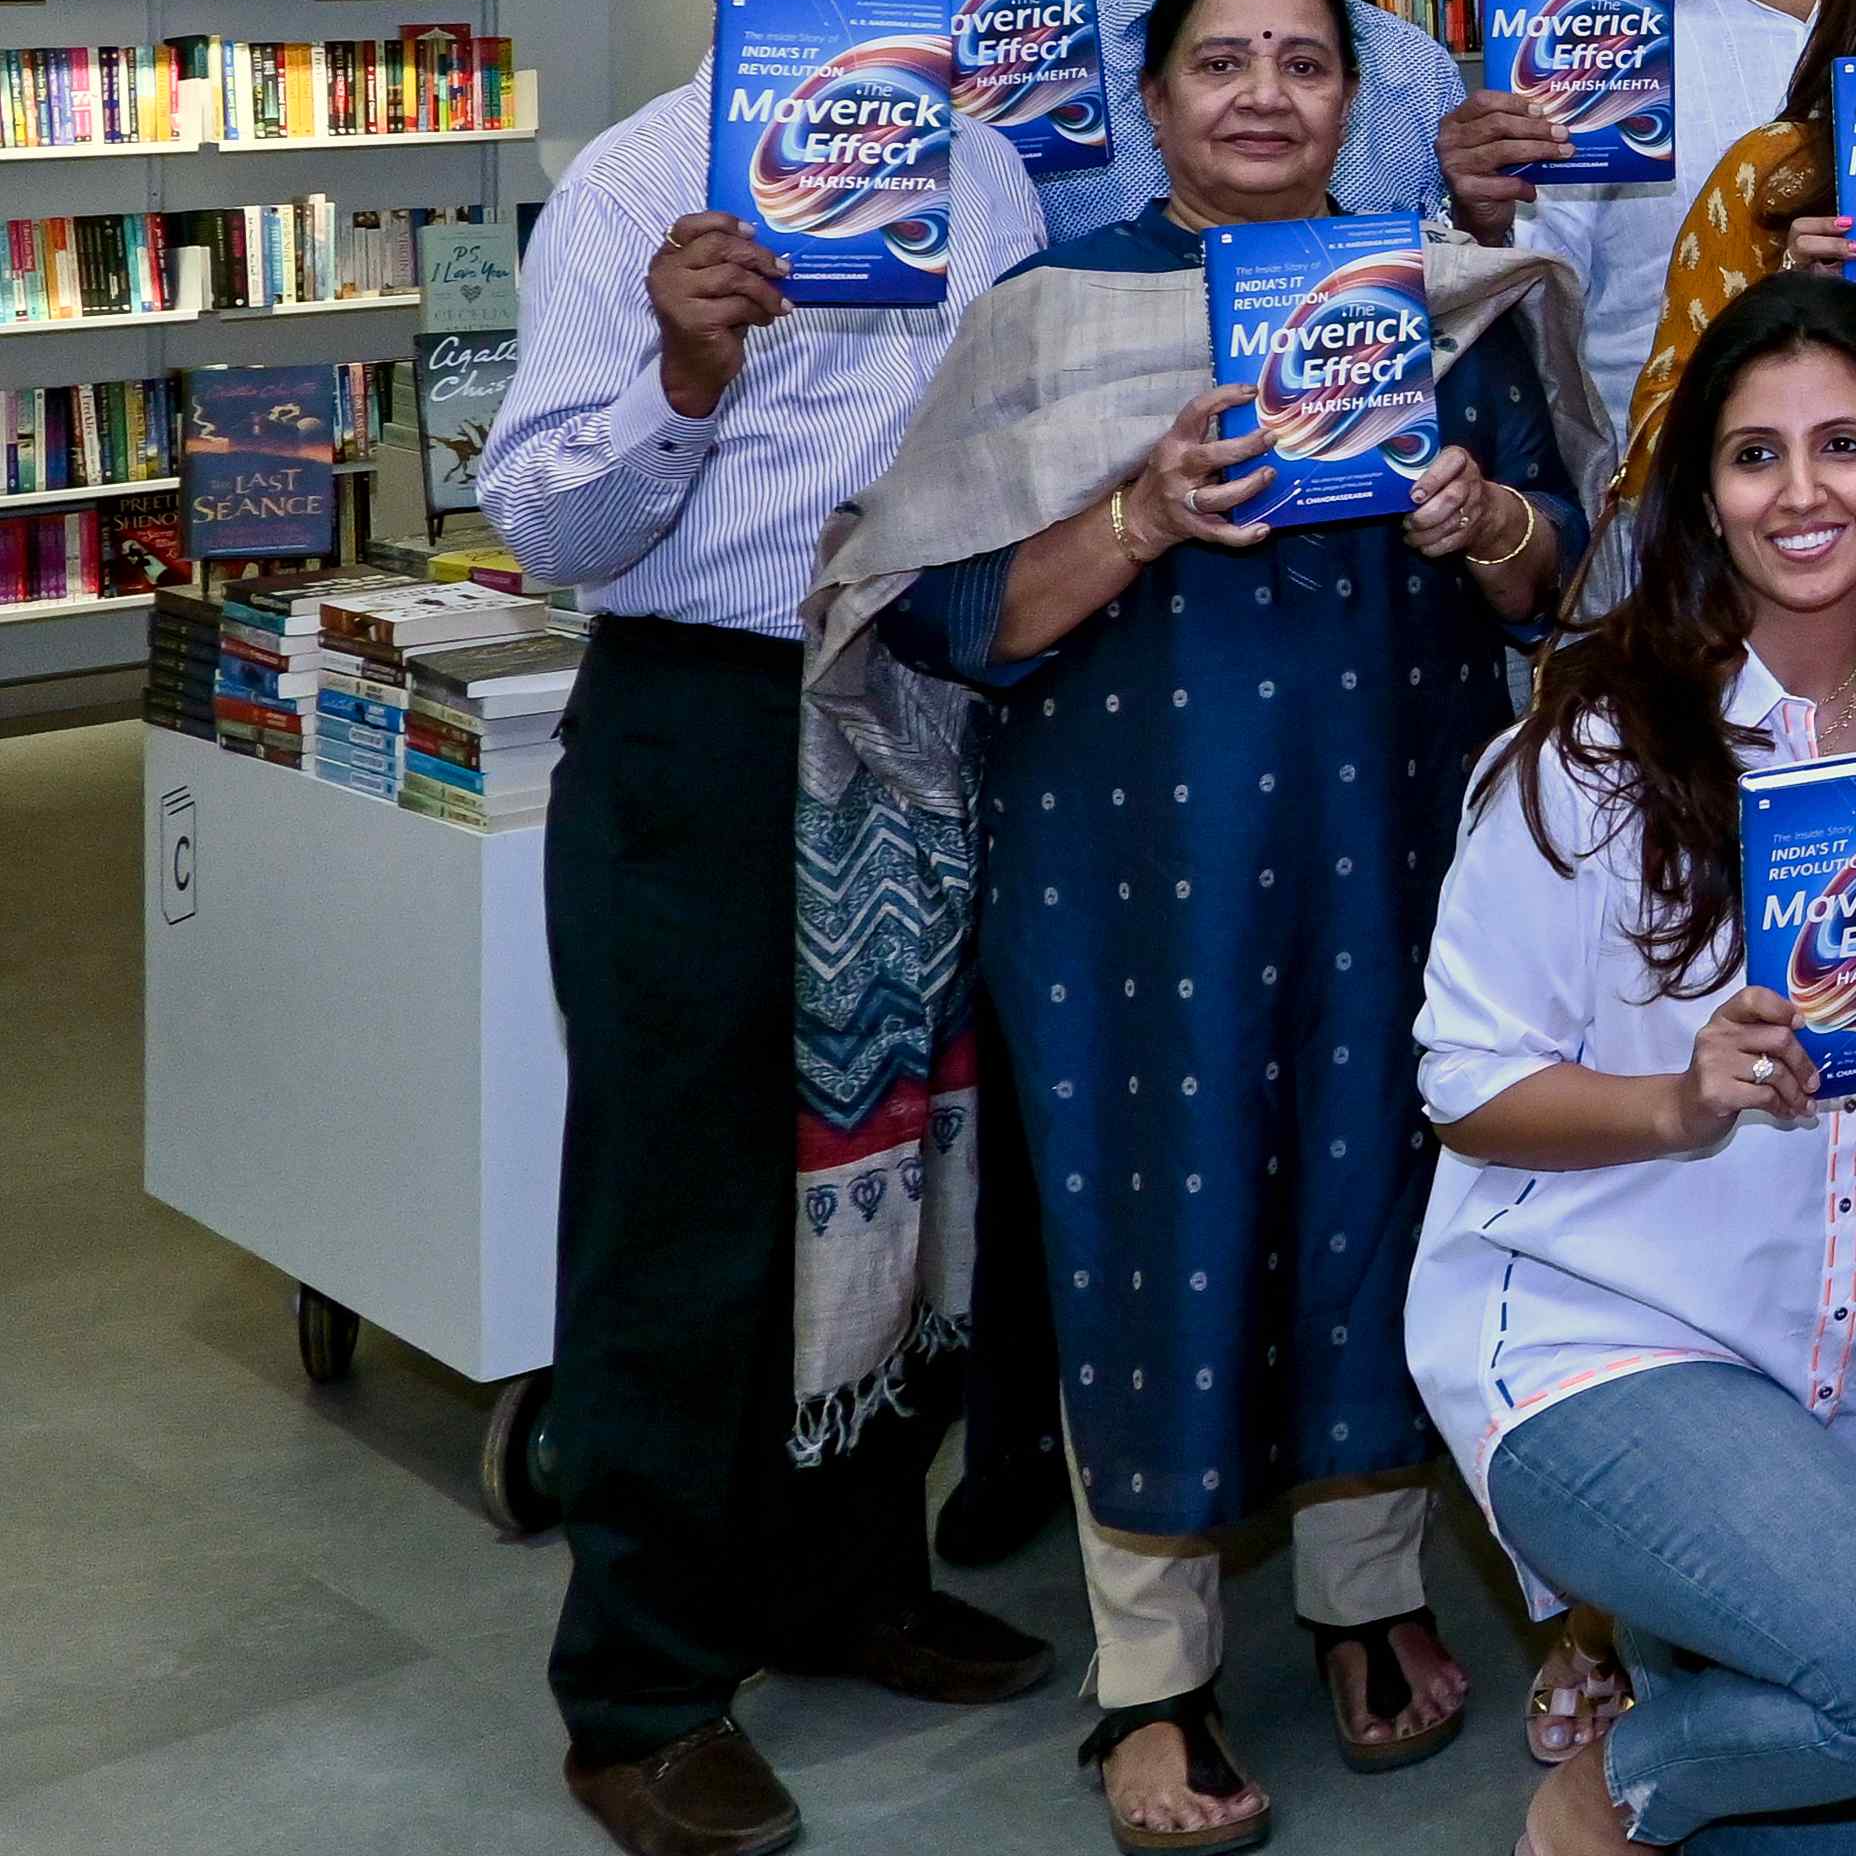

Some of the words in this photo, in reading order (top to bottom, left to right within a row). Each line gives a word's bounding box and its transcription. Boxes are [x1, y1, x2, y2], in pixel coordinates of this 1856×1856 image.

[1492, 7, 1663, 37] Maverick
[977, 35, 1071, 66] Effect
[1553, 44, 1646, 70] Effect
[728, 87, 945, 127] Maverick
[803, 133, 922, 165] Effect
[1231, 309, 1422, 357] Maverick
[1302, 352, 1407, 390] Effect
[235, 468, 304, 495] LAST
[113, 514, 181, 531] SHENO
